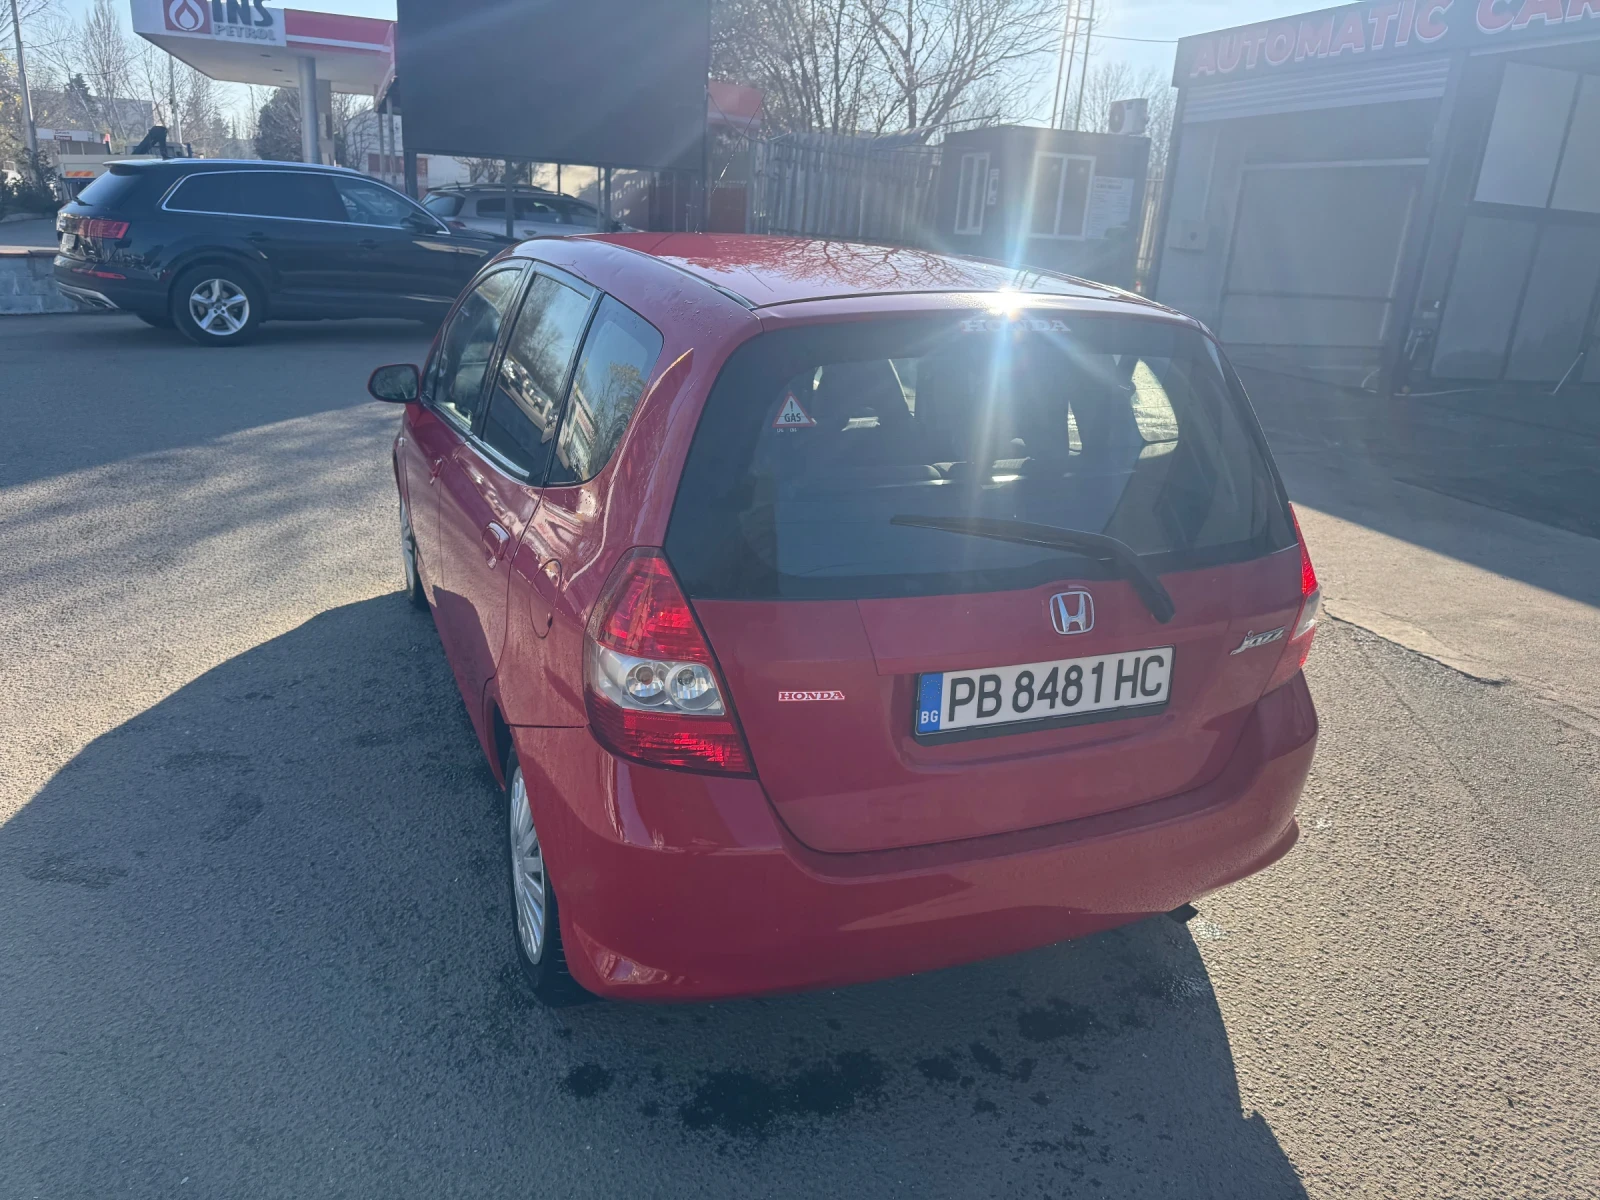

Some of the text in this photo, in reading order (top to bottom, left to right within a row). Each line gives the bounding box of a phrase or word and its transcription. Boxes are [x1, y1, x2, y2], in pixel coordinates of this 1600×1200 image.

[212, 0, 273, 27] INS
[214, 24, 276, 40] PETROL
[1190, 0, 1454, 76] AUTOMATIC
[961, 320, 1071, 332] HONDA
[784, 413, 801, 422] GAS
[778, 691, 845, 701] HONDA
[948, 655, 1165, 722] PB 8481 HC
[921, 709, 939, 724] BG
